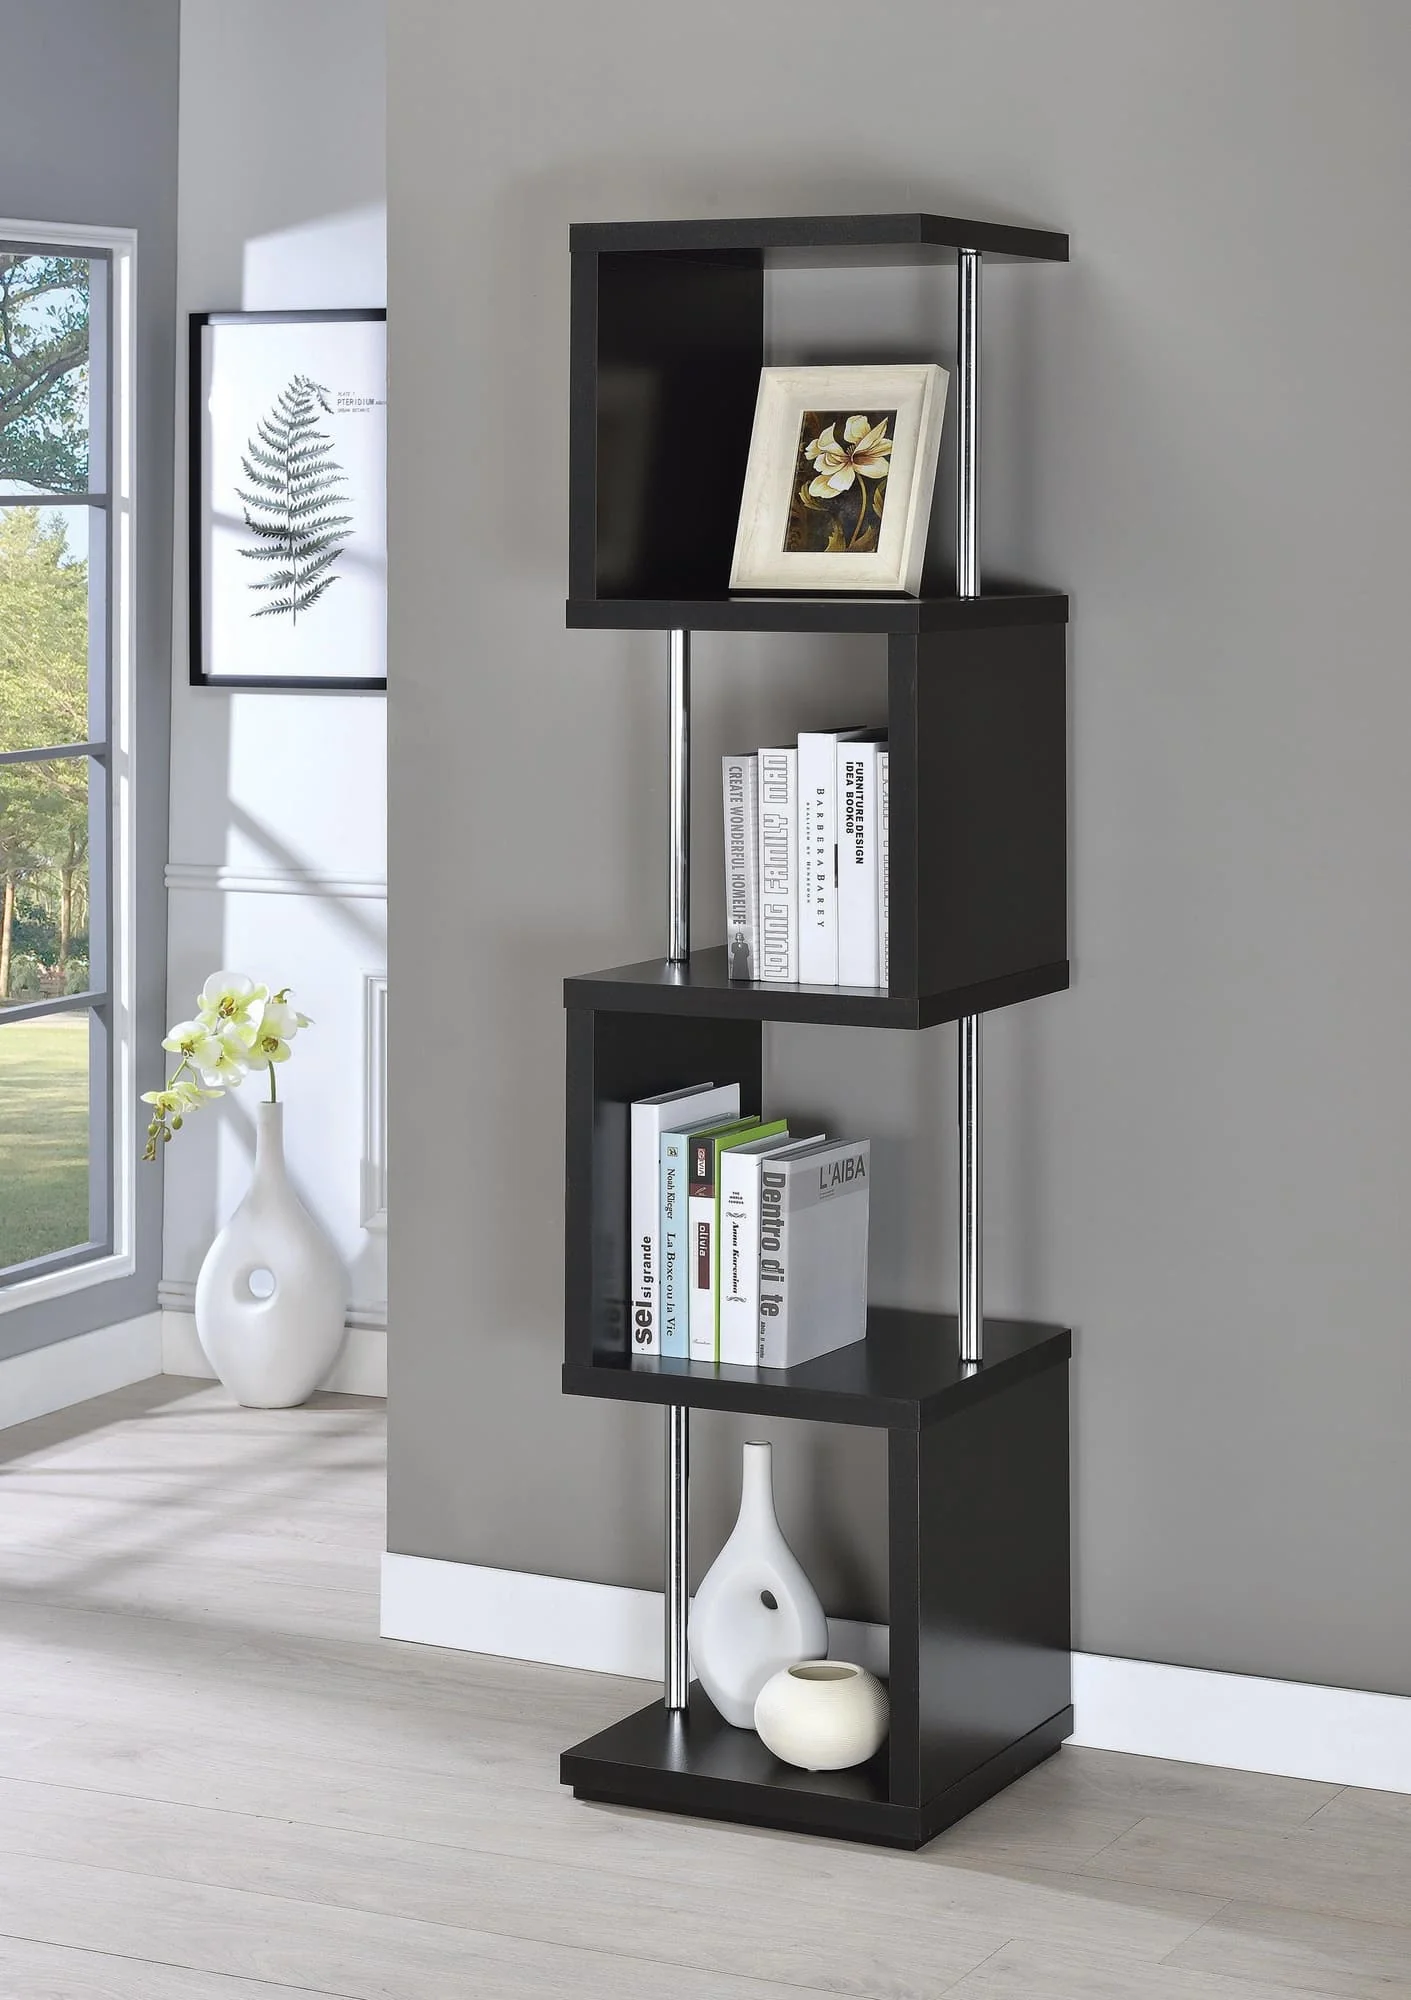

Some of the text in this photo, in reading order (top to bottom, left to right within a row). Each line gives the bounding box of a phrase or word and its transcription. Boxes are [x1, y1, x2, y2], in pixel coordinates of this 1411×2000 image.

[337, 398, 375, 406] PTERIDIUM
[845, 761, 854, 834] IDEA BOOK08
[855, 761, 864, 865] FURNITURE DESIGN
[729, 766, 747, 925] CREATE WONDERFUL HOMELIFE
[762, 755, 789, 978] LOVING FAMILY MAN
[664, 1168, 676, 1220] Noah Klieger
[819, 1154, 866, 1190] L'AIBA
[640, 1235, 654, 1284] grande
[699, 1225, 709, 1257] olivia
[732, 1221, 740, 1247] Anna
[760, 1171, 787, 1317] Dentro di te
[666, 1231, 676, 1337] La Boxe ou la Vie
